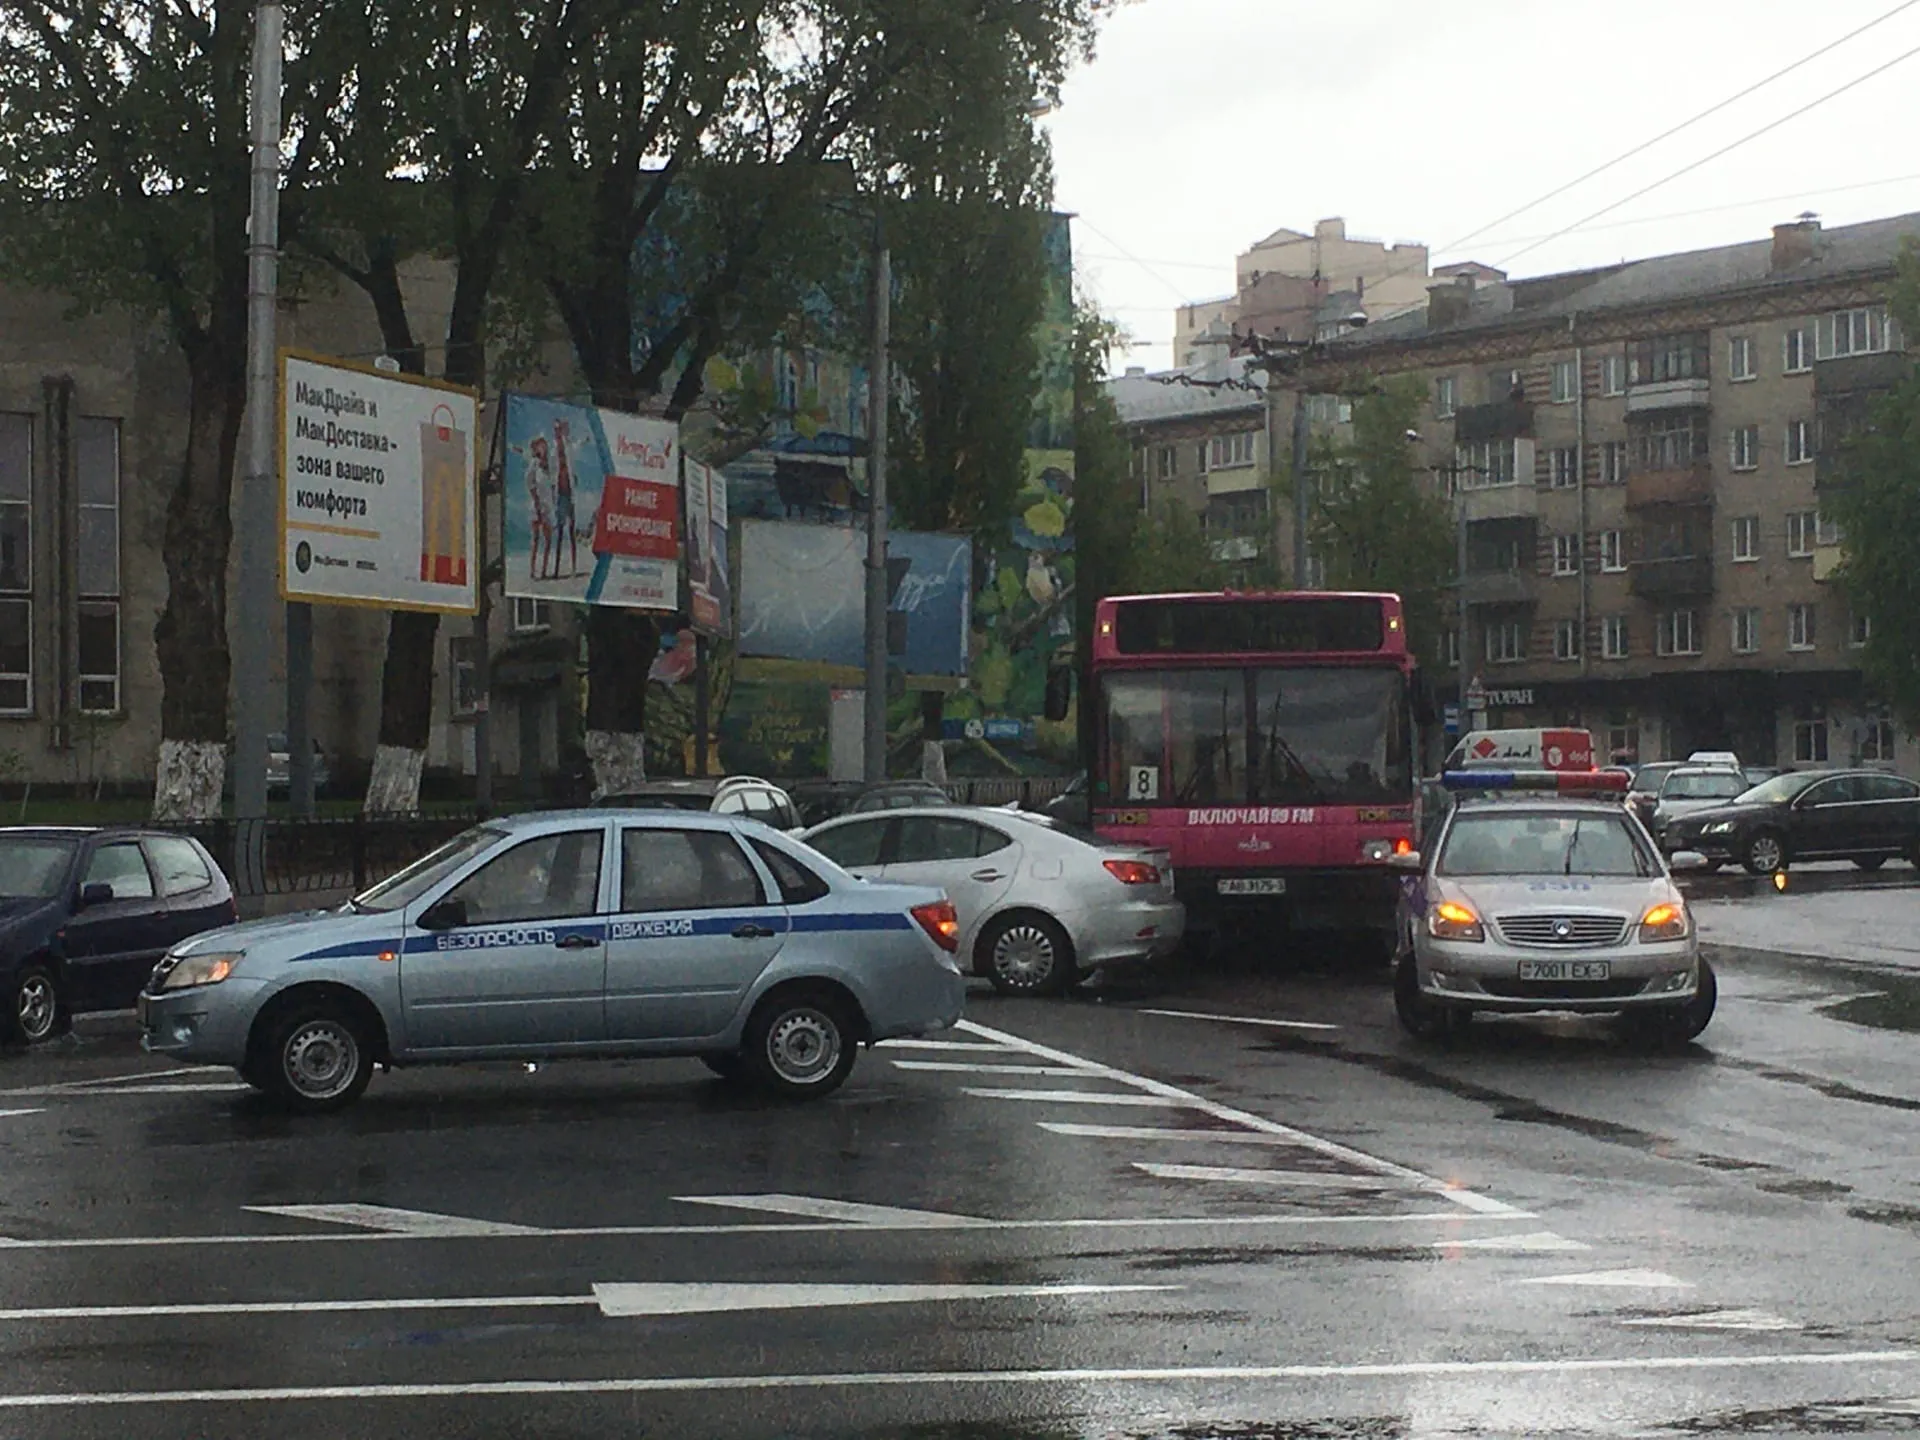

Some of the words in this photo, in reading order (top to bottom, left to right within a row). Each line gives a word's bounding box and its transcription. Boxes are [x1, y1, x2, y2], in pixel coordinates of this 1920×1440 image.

[296, 381, 366, 417] МакДрайв
[369, 400, 378, 418] и
[297, 455, 332, 477] зона
[336, 460, 385, 486] вашего
[297, 488, 367, 520] комфорта
[1138, 769, 1150, 795] 8
[1188, 807, 1269, 825] ВКЛЮЧАЙ
[1292, 807, 1315, 824] FM
[437, 929, 556, 950] БЕЗОПАСНОСТЬ
[612, 919, 694, 939] ДВИЖЕНИЯ
